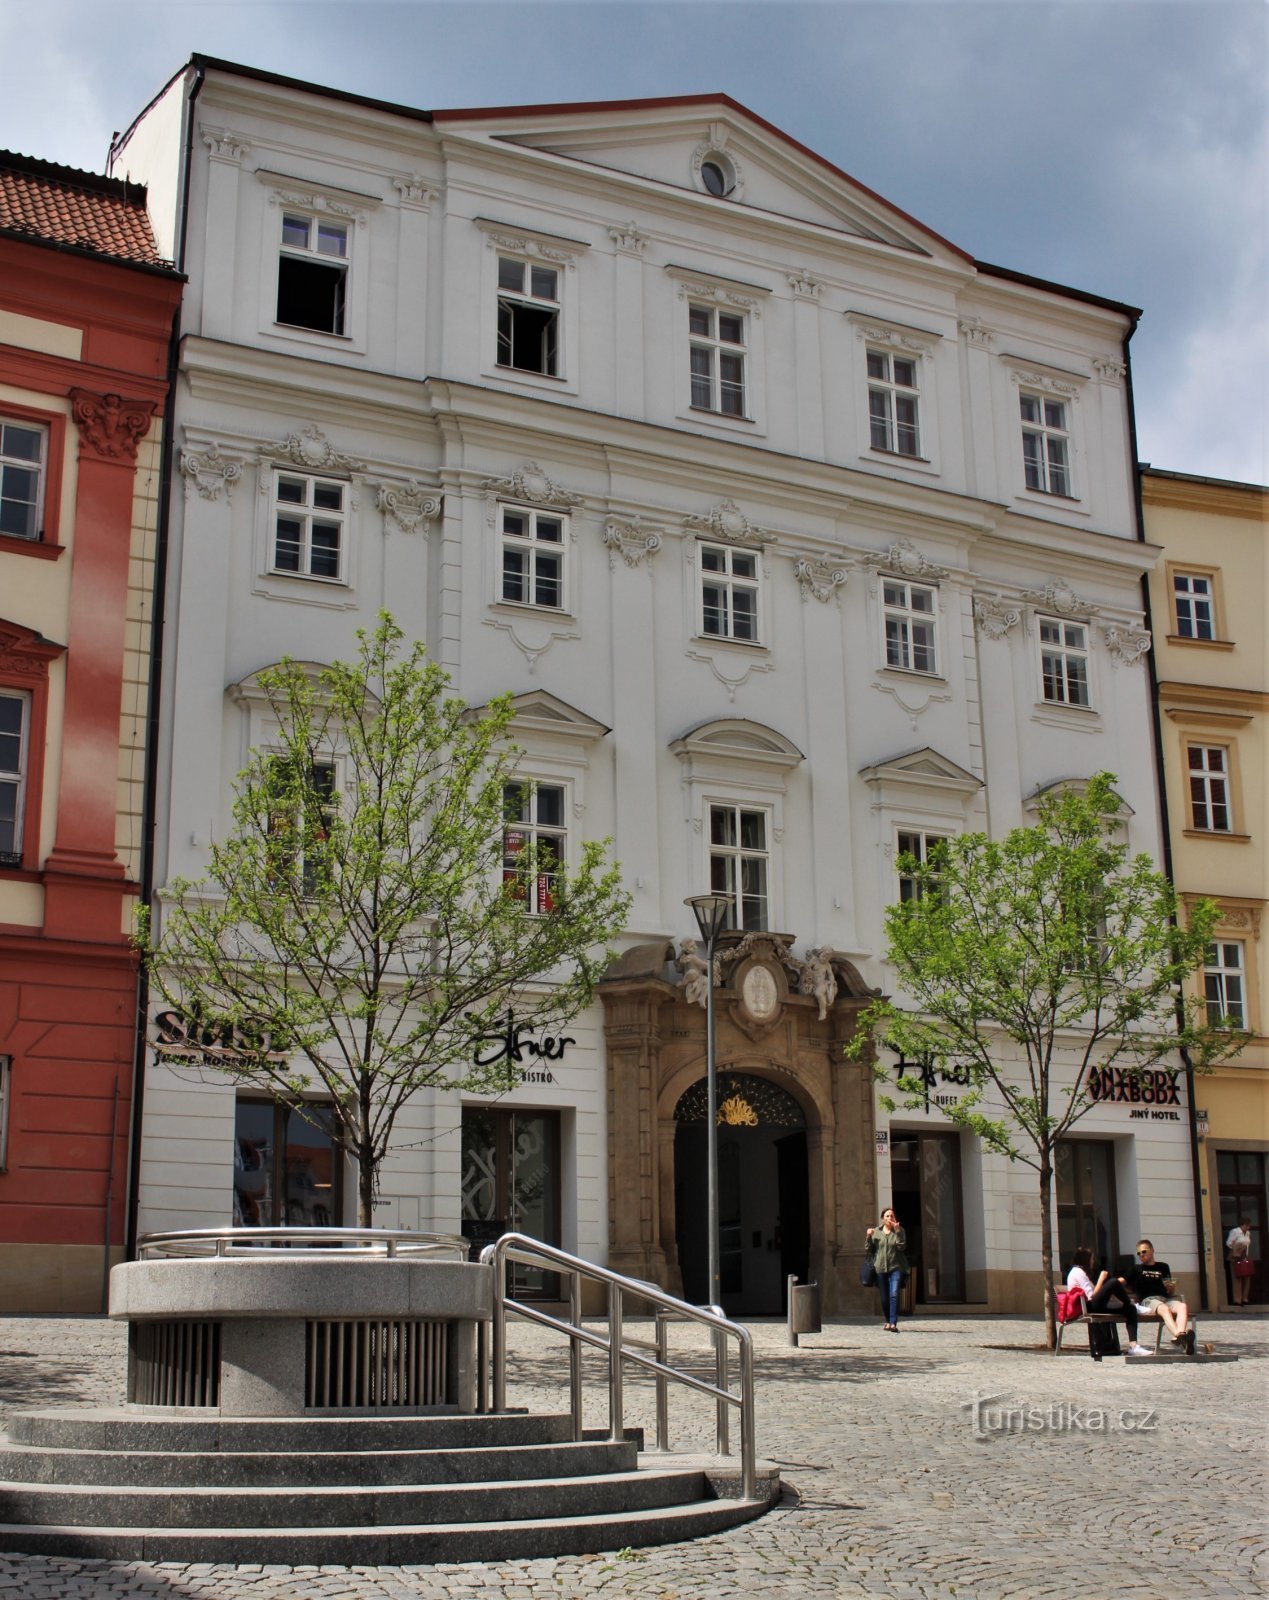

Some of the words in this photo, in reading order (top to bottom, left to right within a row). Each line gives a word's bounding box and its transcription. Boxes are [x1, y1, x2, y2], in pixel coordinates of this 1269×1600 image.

[521, 1071, 552, 1083] BISTRO
[1129, 1107, 1149, 1119] JINÝ
[1151, 1110, 1180, 1121] HOTEL
